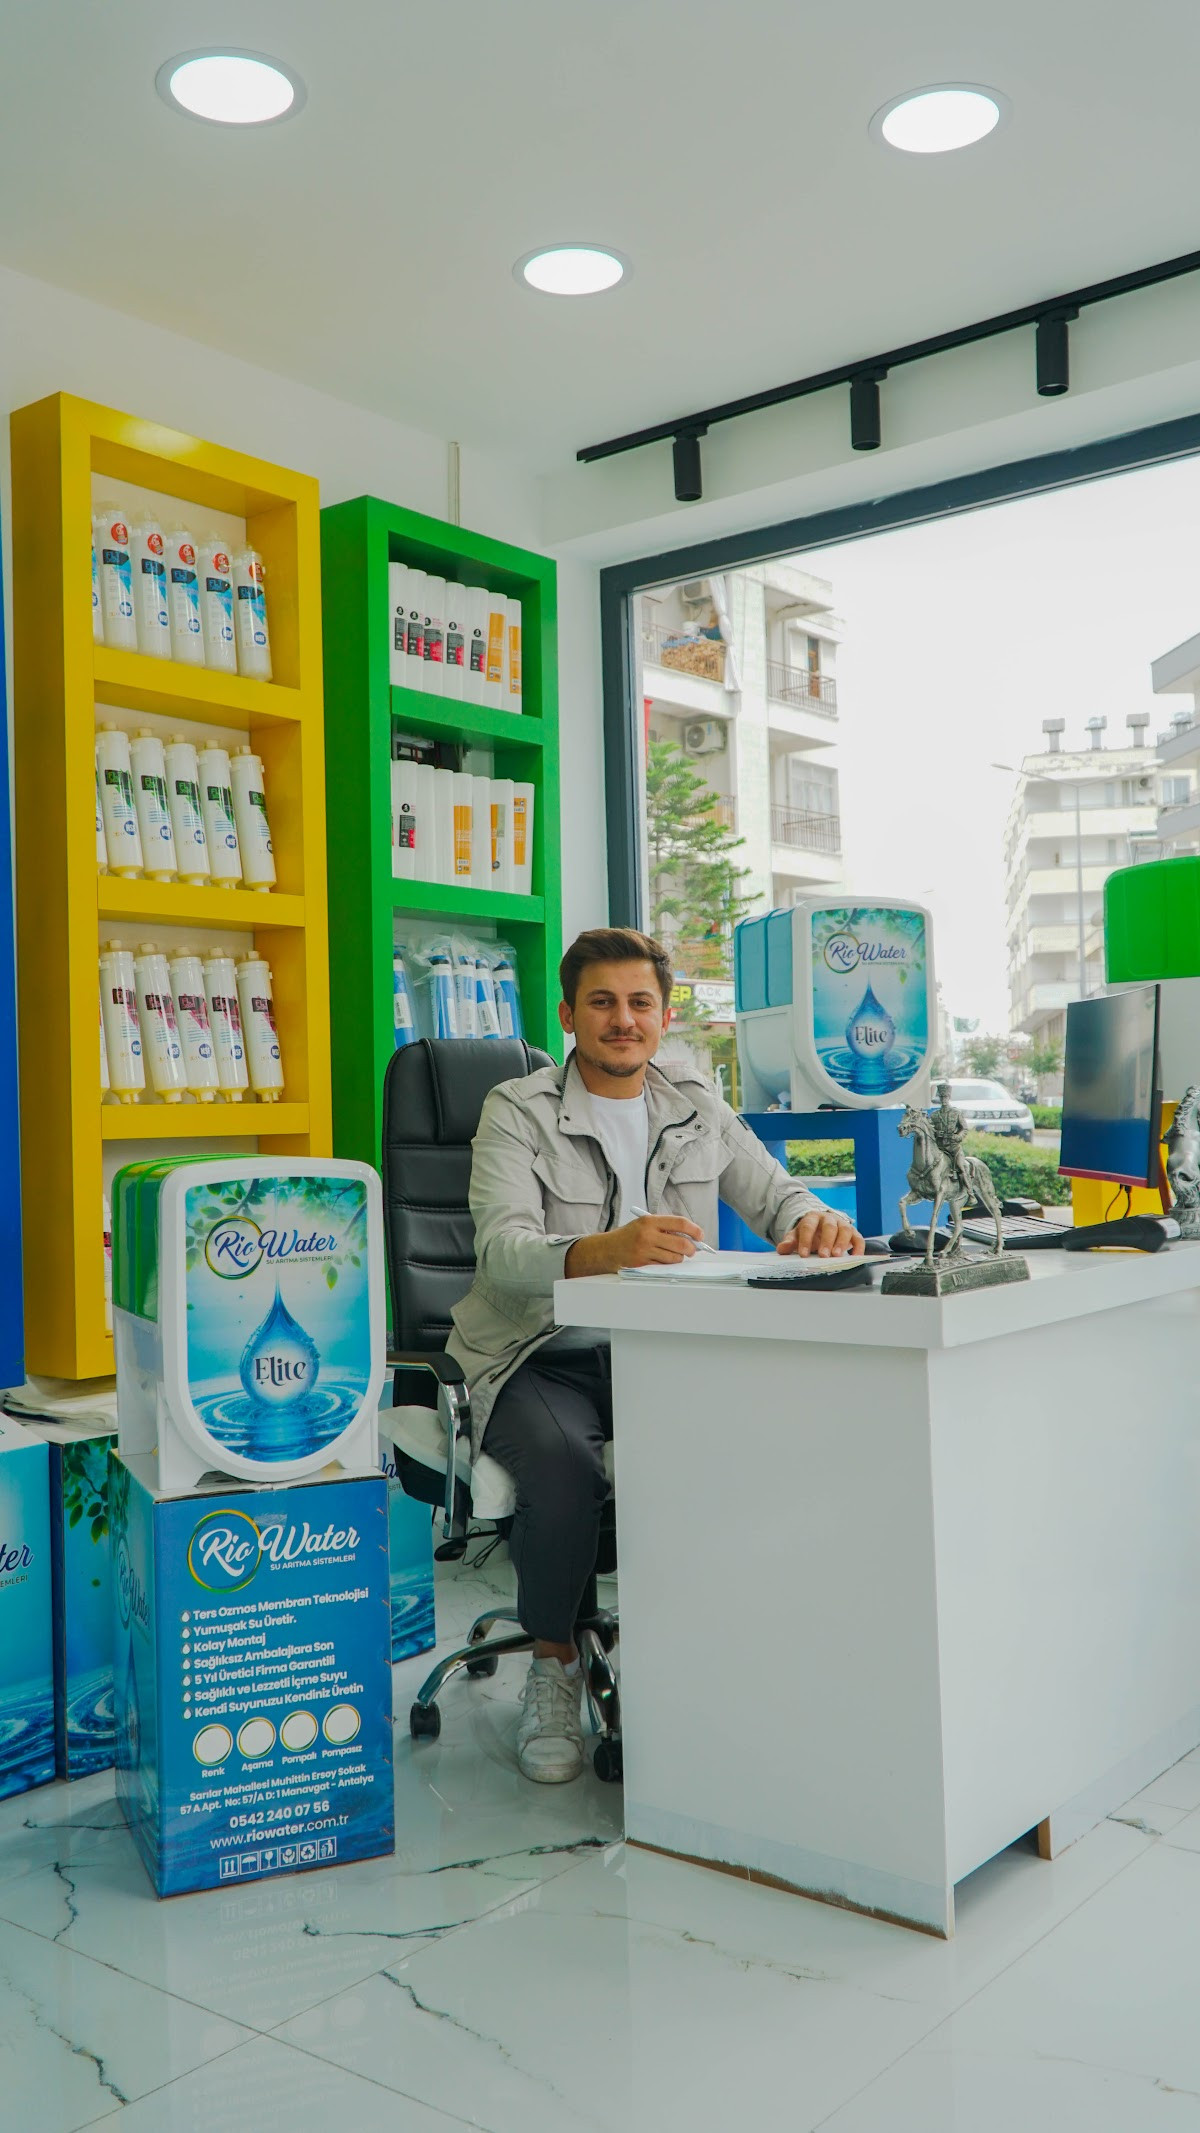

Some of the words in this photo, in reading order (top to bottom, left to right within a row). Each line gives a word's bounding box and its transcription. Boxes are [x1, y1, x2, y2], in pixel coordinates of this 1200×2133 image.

[856, 943, 907, 960] Water
[214, 1230, 257, 1268] Rio
[258, 1229, 337, 1258] Water
[256, 1356, 306, 1386] Elite
[199, 1529, 254, 1577] Rio
[258, 1522, 360, 1562] Water
[270, 1563, 280, 1571] SU
[282, 1560, 311, 1570] ARITMA
[313, 1553, 355, 1566] SİSTEMLERİ
[193, 1610, 217, 1622] Ters
[219, 1605, 256, 1617] Ozmos
[258, 1597, 311, 1612] Membran
[313, 1588, 369, 1605] Teknolojisi
[194, 1621, 246, 1637] Yumuşak
[249, 1618, 262, 1629] Su
[264, 1613, 296, 1627] Üretir.
[194, 1640, 225, 1653] Kolay
[228, 1633, 266, 1648] Montaj
[194, 1655, 243, 1670] Sağlıksız
[245, 1644, 312, 1661] Ambalajlara
[314, 1641, 334, 1651] Son
[195, 1675, 201, 1685] 5
[204, 1672, 217, 1684] Yıl
[220, 1667, 254, 1681] Üretici
[256, 1663, 287, 1675] Firma
[289, 1655, 335, 1671] Garantili
[195, 1686, 235, 1702] Sağlıklı
[237, 1685, 250, 1694] ve
[252, 1678, 290, 1693] Lezzetli
[292, 1674, 318, 1689] İçme
[321, 1671, 347, 1685] Suyu
[195, 1705, 227, 1718] Kendi
[229, 1697, 283, 1713] Suyunuzu
[285, 1689, 330, 1704] Kendiniz
[332, 1682, 363, 1697] Üretin
[242, 1759, 273, 1773] Aşama
[282, 1752, 316, 1765] Pompalı
[322, 1745, 362, 1759] Pompasız
[190, 1789, 222, 1801] Sarılar
[224, 1780, 270, 1795] Mahallesi
[272, 1773, 310, 1788] Muhittin
[312, 1769, 336, 1782] Ersoy
[339, 1765, 366, 1776] Sokak
[202, 1767, 225, 1778] Renk
[180, 1806, 191, 1815] 57
[193, 1804, 200, 1813] A
[202, 1801, 222, 1814] Apt.
[225, 1797, 241, 1807] No:
[243, 1792, 264, 1804] 57/A
[266, 1791, 275, 1800] D:
[277, 1789, 280, 1798] 1
[282, 1781, 329, 1797] Manavgat
[338, 1774, 374, 1788] Antalya
[230, 1812, 264, 1828] 0542
[267, 1808, 291, 1823] 240
[295, 1804, 310, 1817] 07
[313, 1801, 330, 1813] 56
[210, 1814, 348, 1849] www.riowater.com.tr
